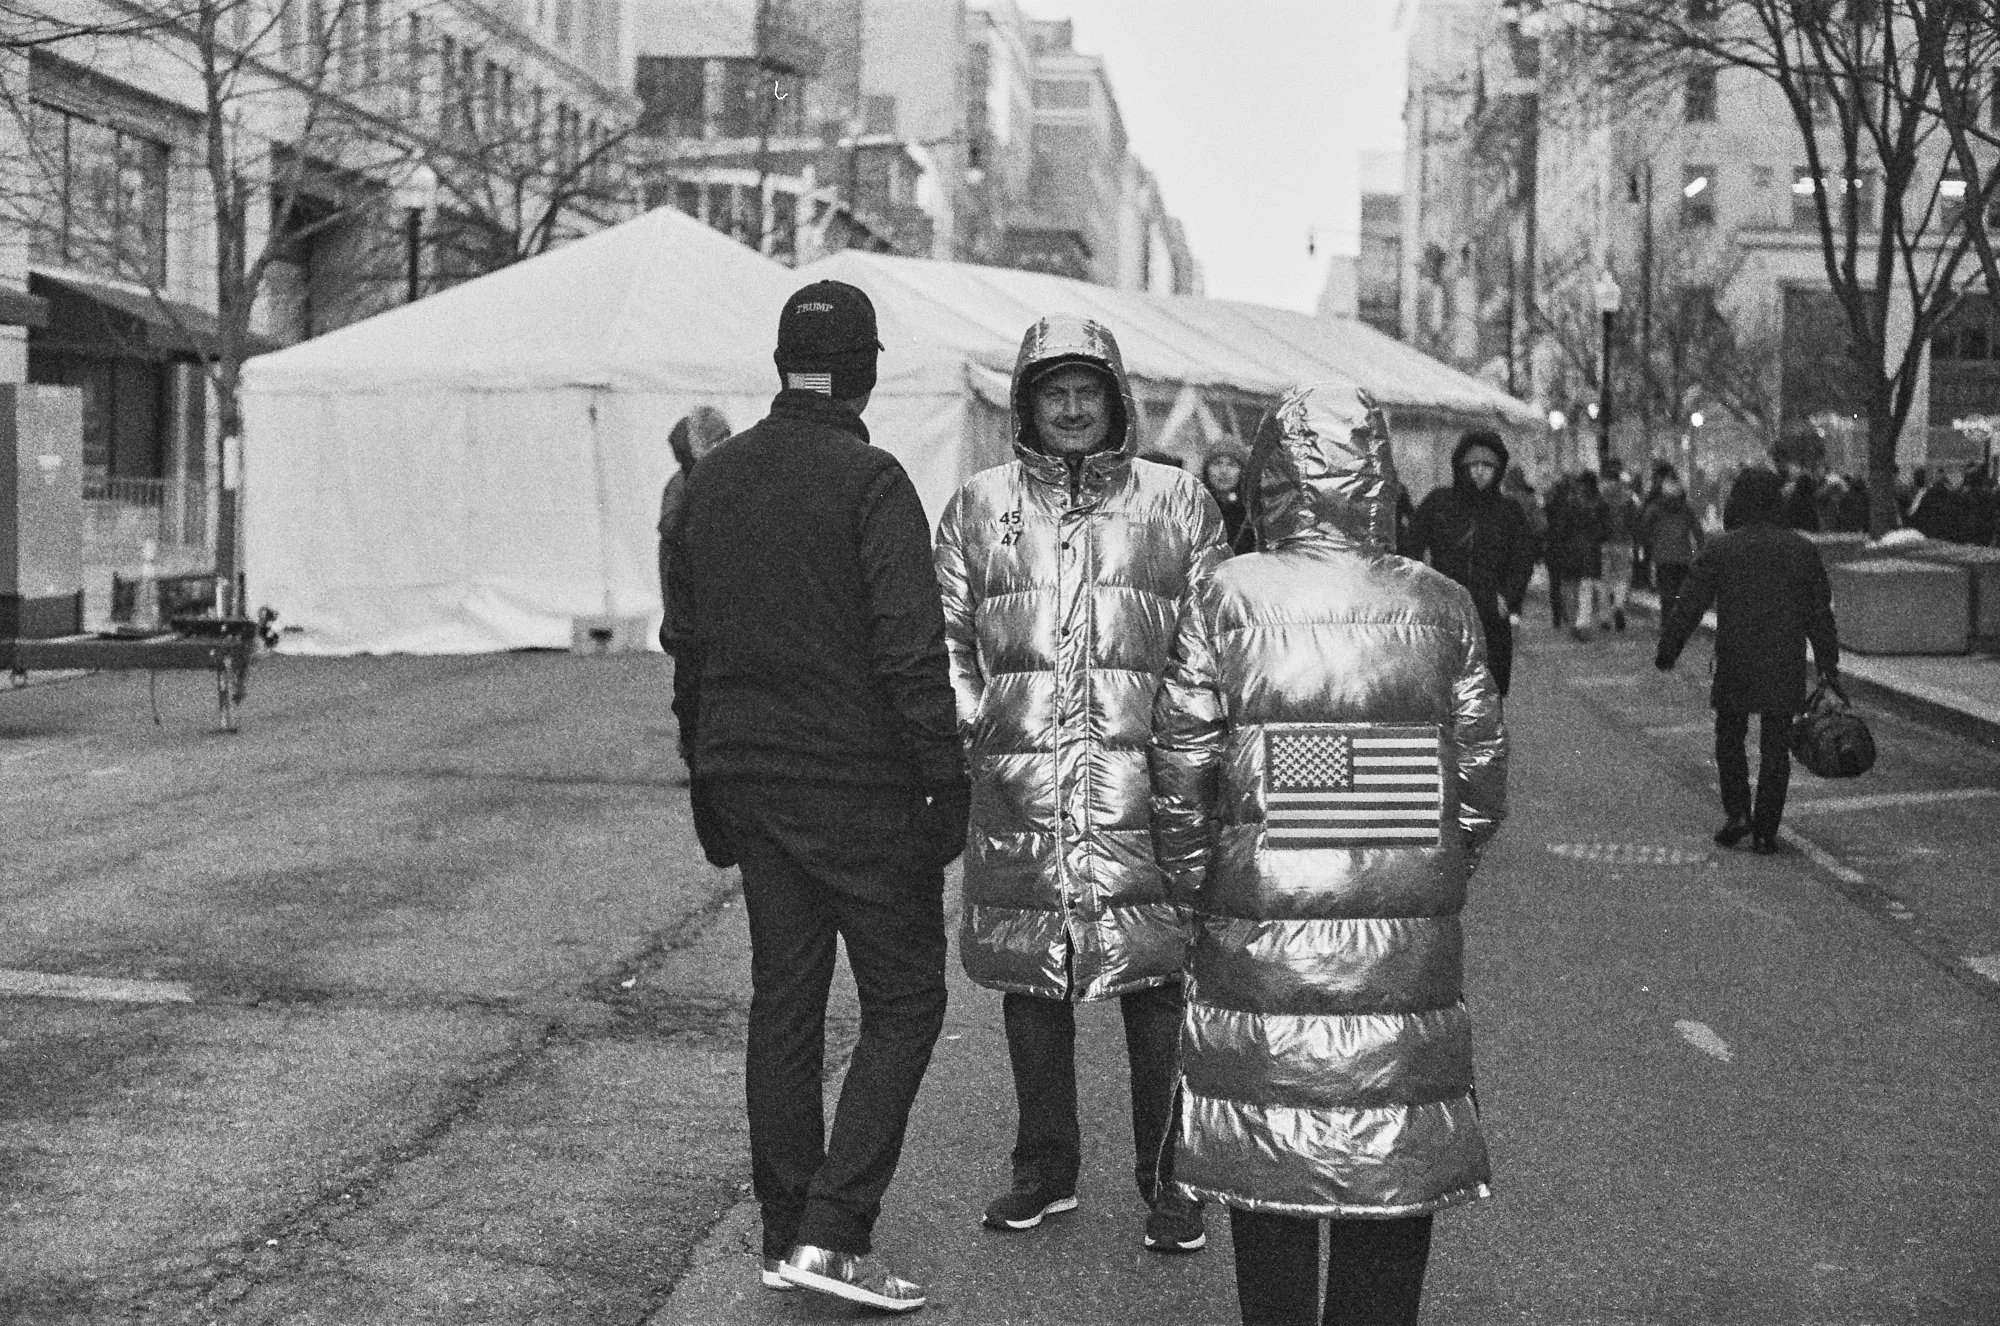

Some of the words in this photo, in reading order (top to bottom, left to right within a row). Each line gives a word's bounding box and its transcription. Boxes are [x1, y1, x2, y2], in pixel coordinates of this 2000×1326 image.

[796, 302, 833, 314] TRUMP
[999, 510, 1020, 525] 45
[1001, 531, 1022, 546] 47
